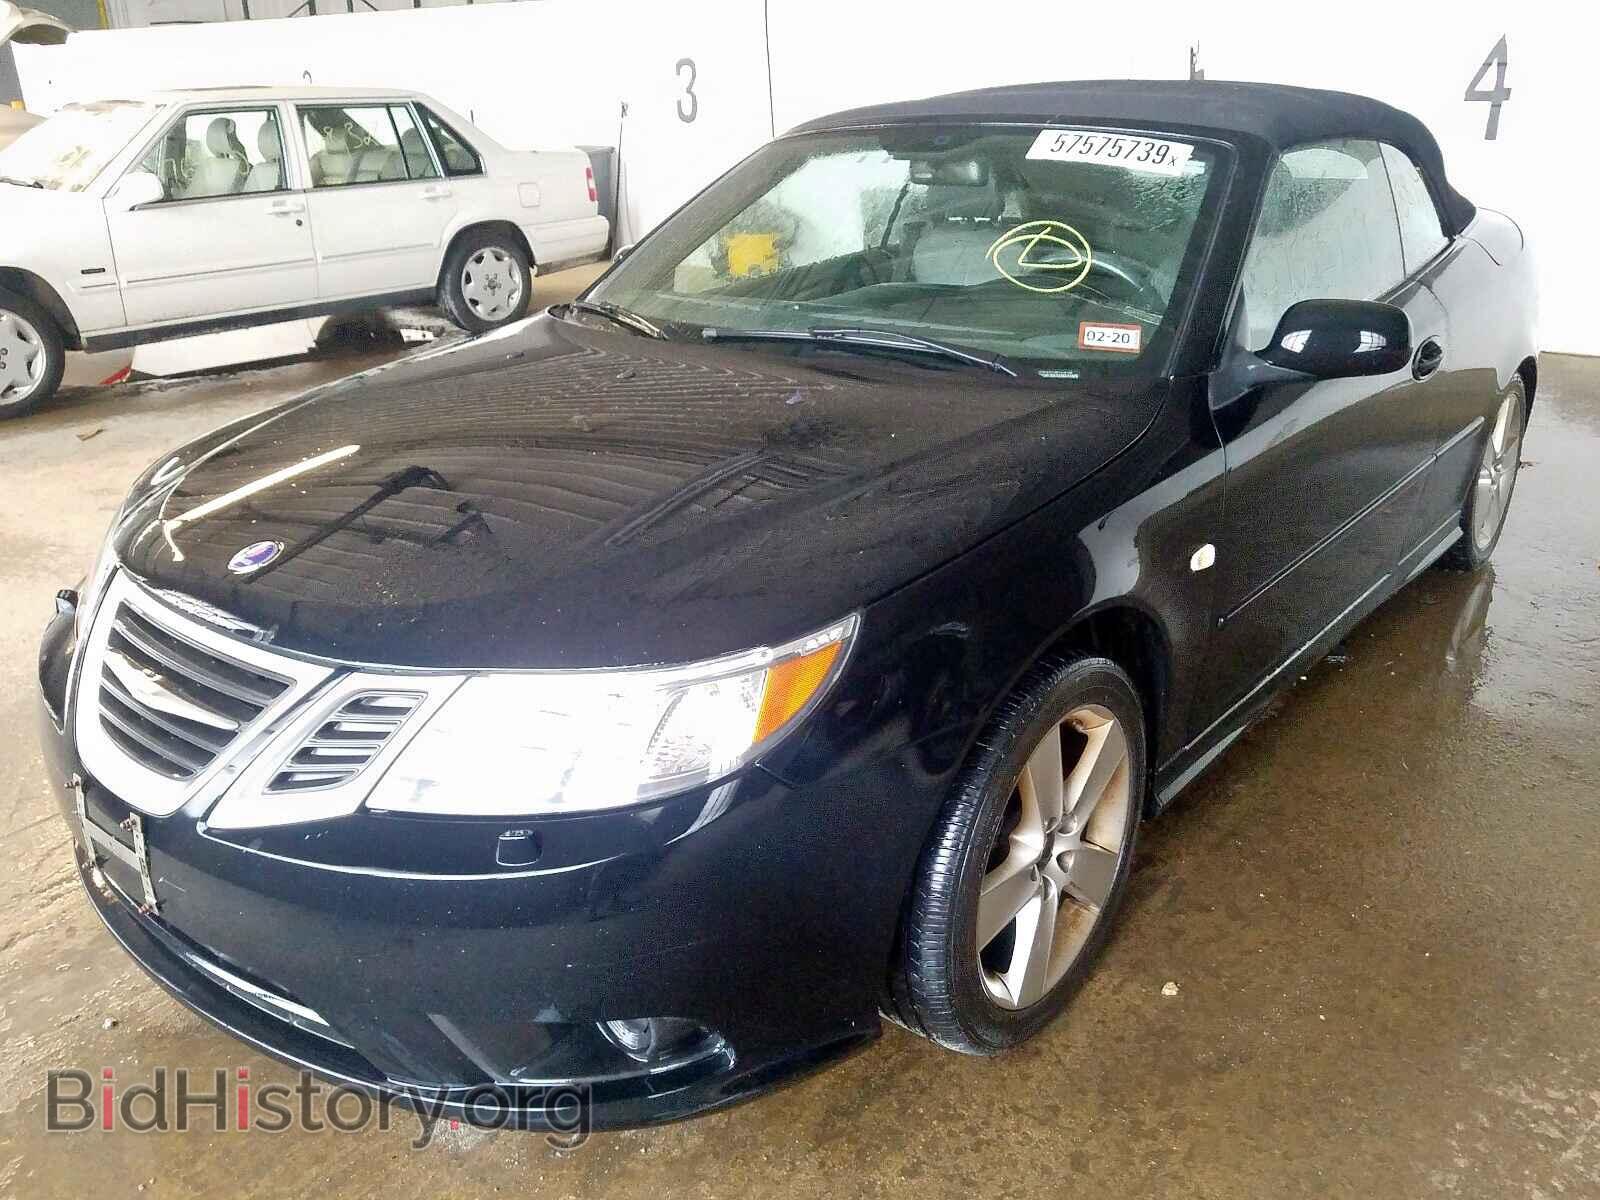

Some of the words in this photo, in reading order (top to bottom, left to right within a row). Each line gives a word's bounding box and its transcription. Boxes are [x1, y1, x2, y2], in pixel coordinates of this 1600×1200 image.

[676, 58, 697, 123] 3
[1464, 33, 1512, 140] 4
[1086, 330, 1130, 344] 02-20
